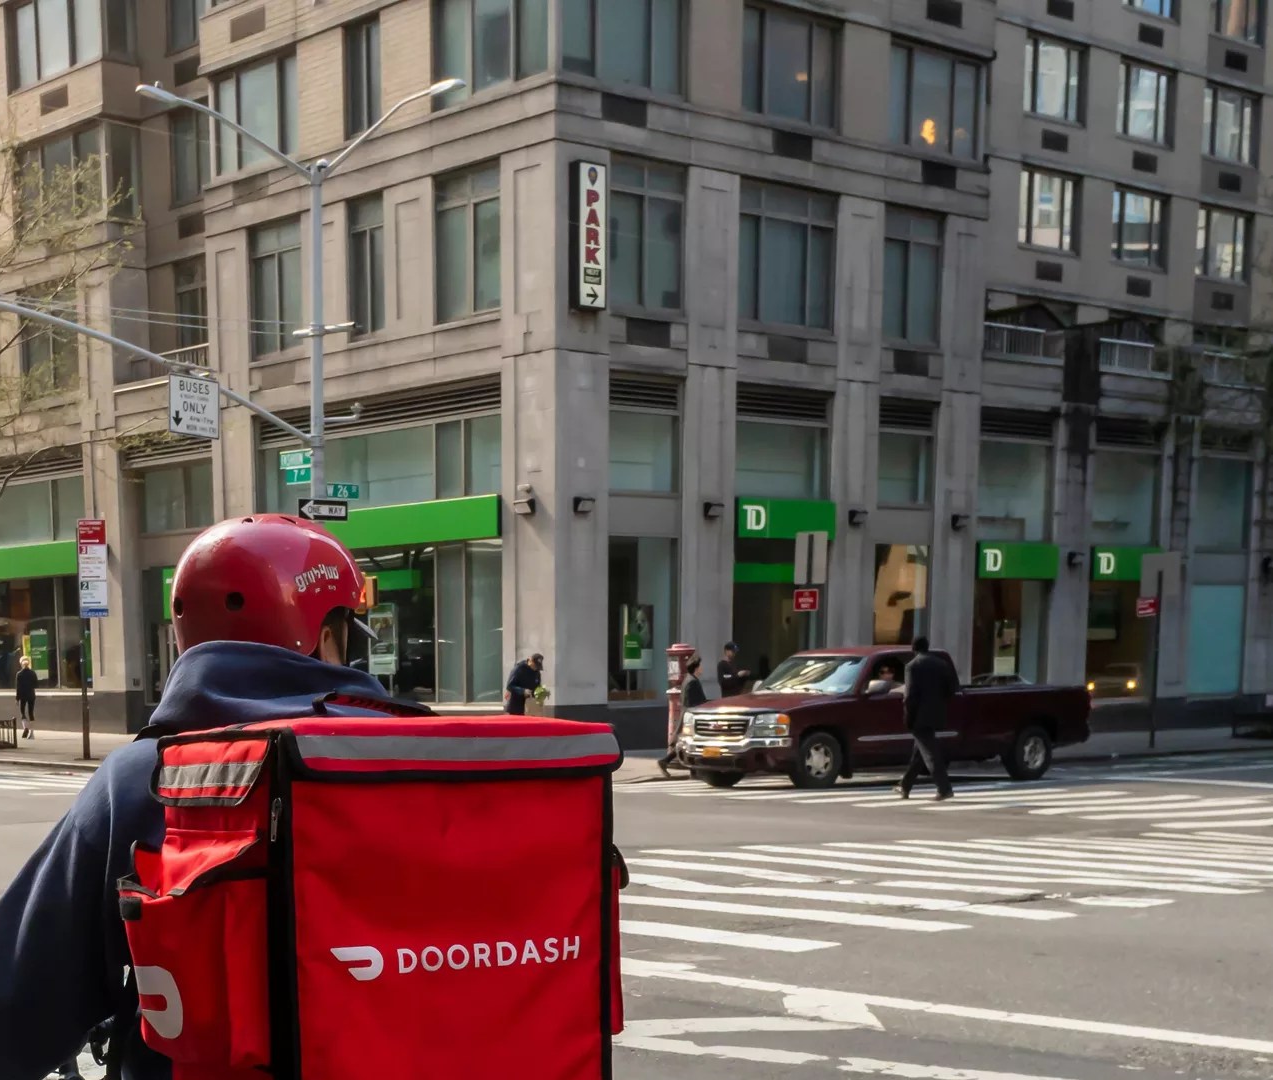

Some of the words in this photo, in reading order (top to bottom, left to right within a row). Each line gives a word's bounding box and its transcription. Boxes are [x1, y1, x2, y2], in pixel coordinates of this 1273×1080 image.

[585, 189, 601, 265] PARK
[179, 380, 210, 396] BUSES
[182, 400, 207, 415] ONLY
[293, 469, 298, 482] 7
[327, 485, 334, 497] W
[337, 485, 348, 498] 26
[307, 505, 322, 515] ONE
[328, 506, 343, 515] WAY
[742, 504, 766, 531] TD
[983, 548, 1003, 572] TD
[1097, 552, 1115, 575] TD
[82, 581, 88, 590] 2
[396, 935, 580, 974] DOORDASH
